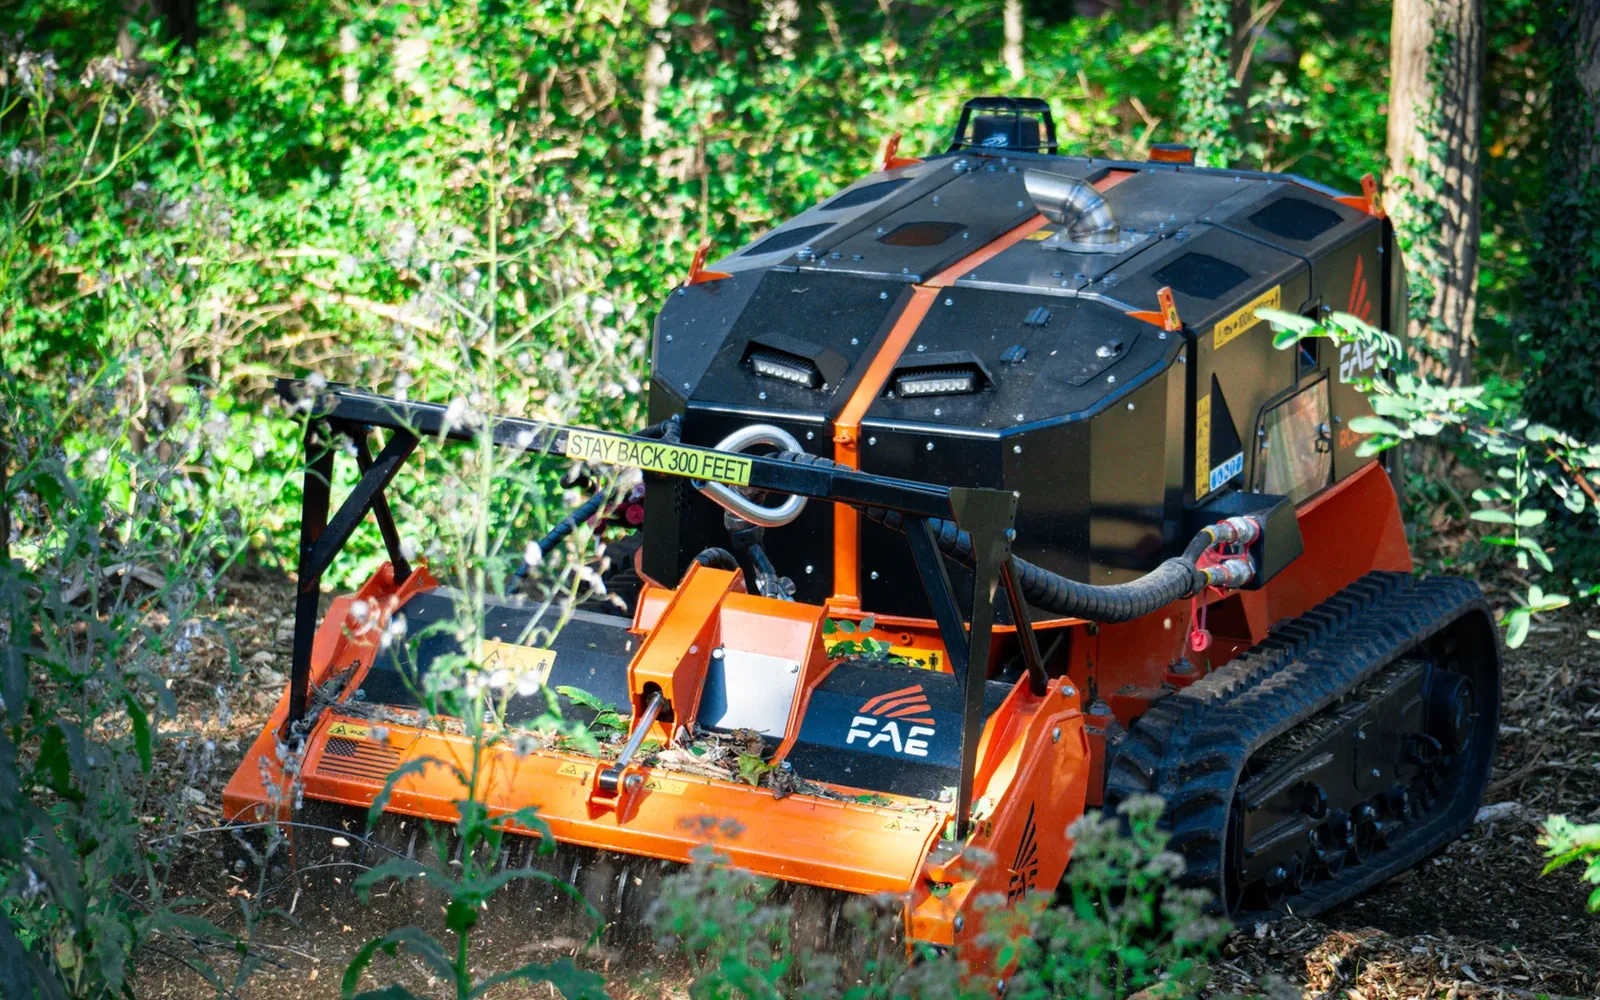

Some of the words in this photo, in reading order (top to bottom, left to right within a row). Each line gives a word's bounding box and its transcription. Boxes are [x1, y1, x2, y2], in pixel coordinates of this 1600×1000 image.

[570, 434, 614, 460] STAY
[617, 441, 667, 469] BACK
[668, 450, 698, 474] 300
[701, 455, 748, 483] FEET
[846, 716, 935, 757] FAE
